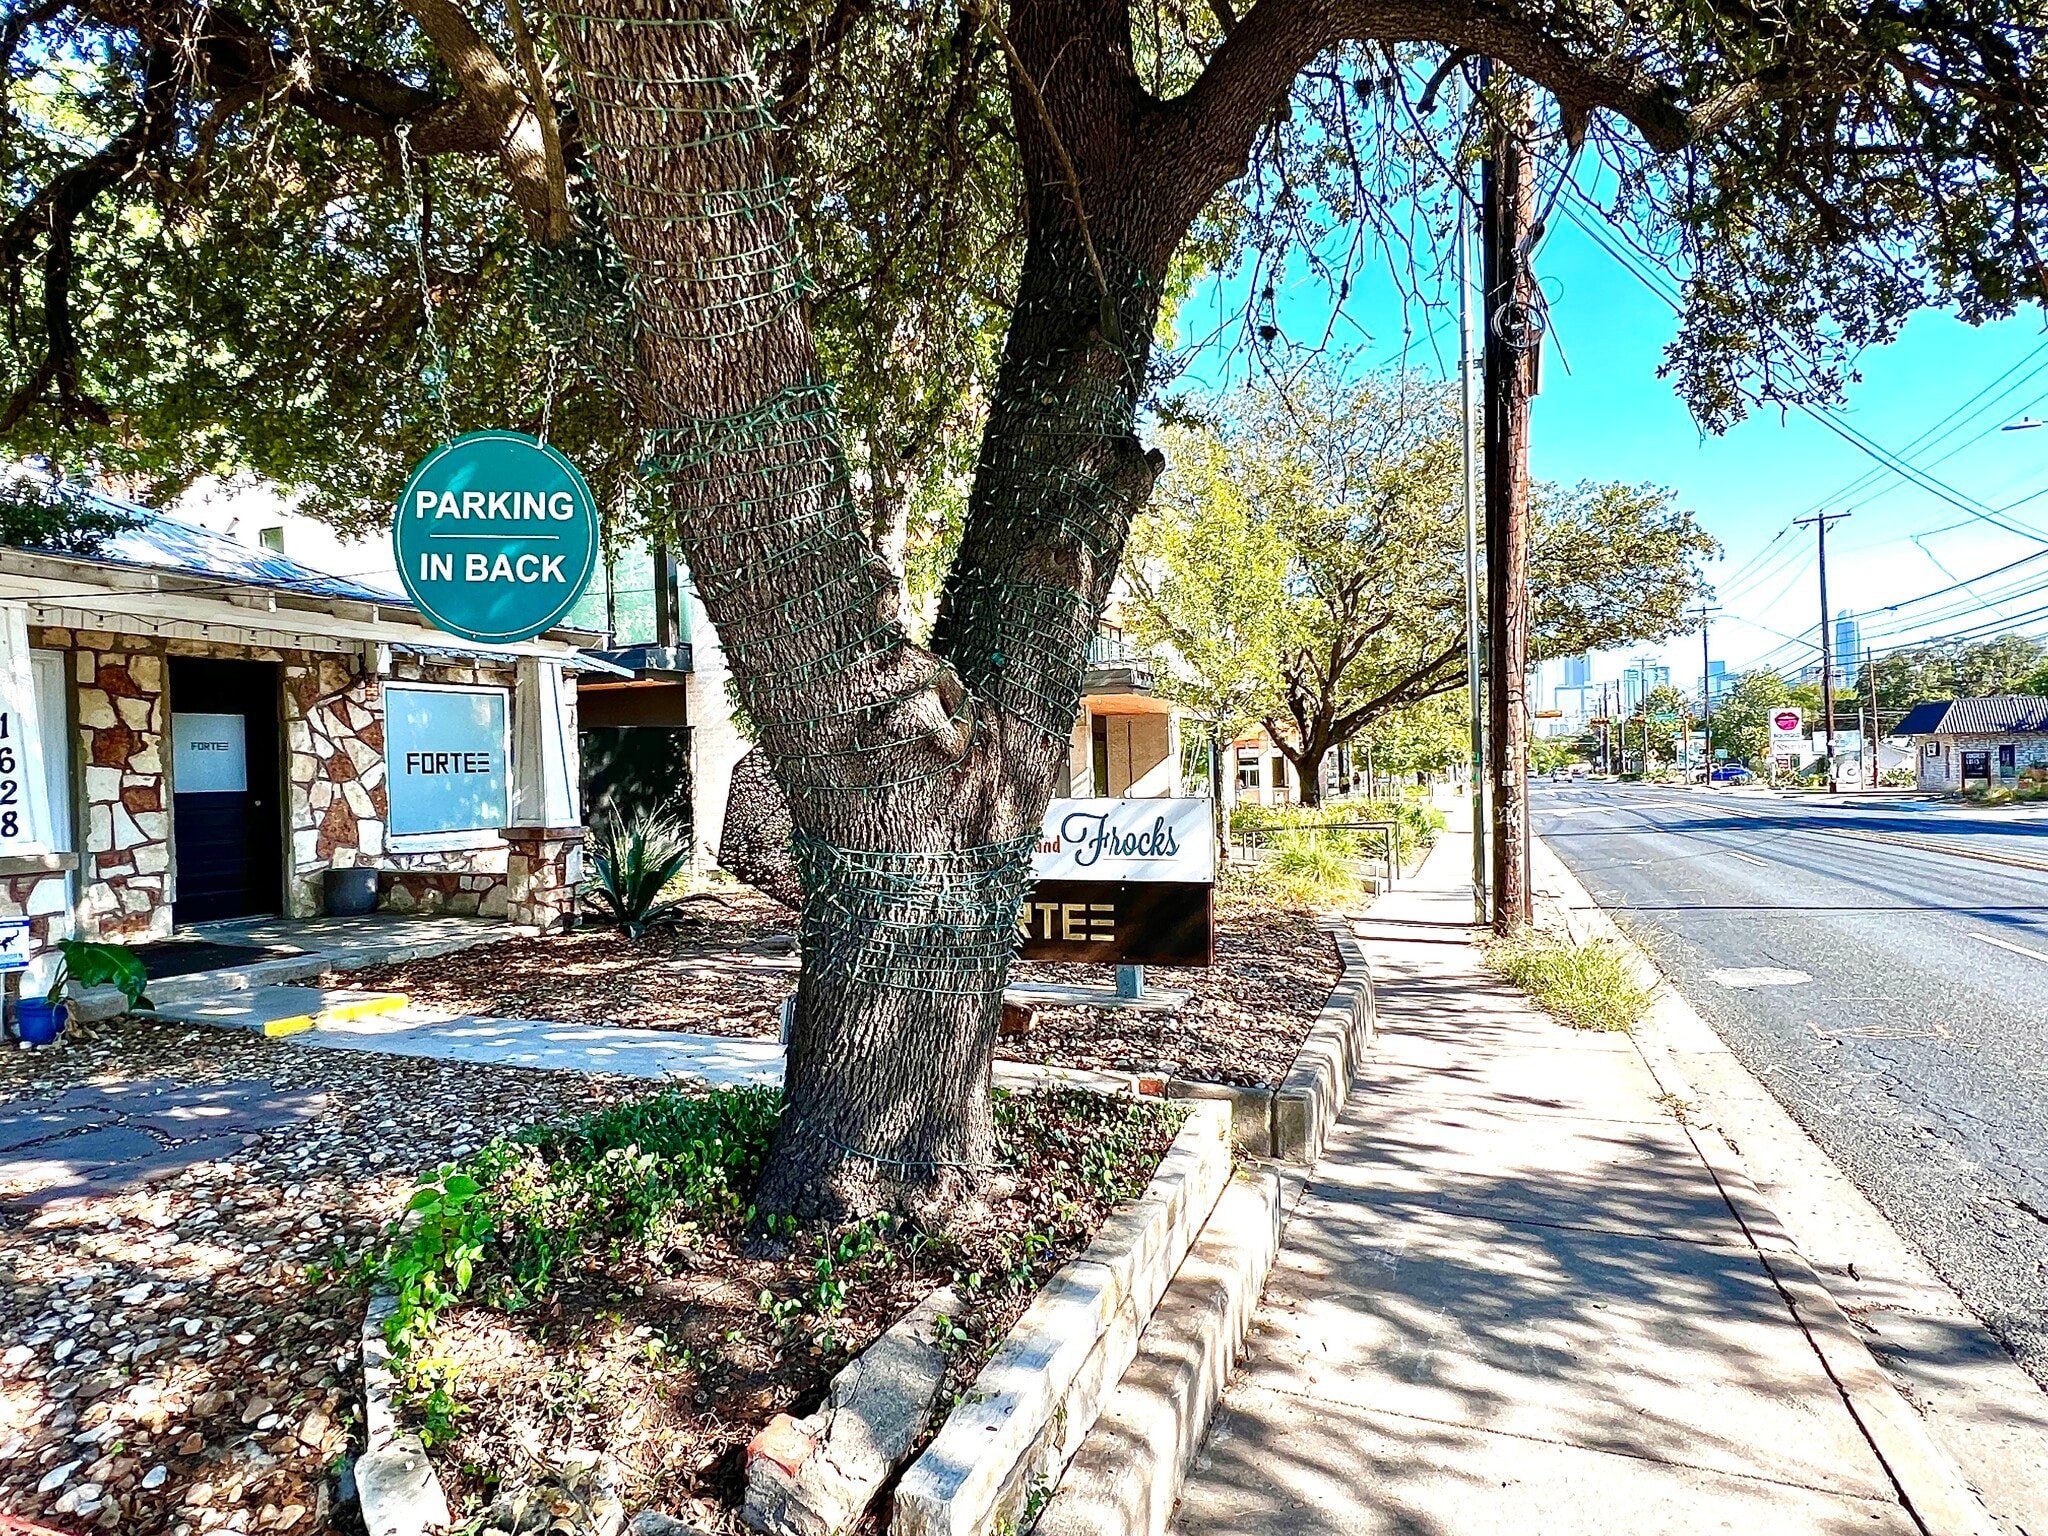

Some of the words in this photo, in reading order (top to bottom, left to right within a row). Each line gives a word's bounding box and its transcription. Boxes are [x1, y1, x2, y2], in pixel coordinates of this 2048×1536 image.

[415, 490, 575, 522] PARKING
[420, 552, 453, 582] IN
[465, 553, 567, 584] BACK
[1035, 834, 1061, 854] and
[1061, 812, 1181, 867] Frocks
